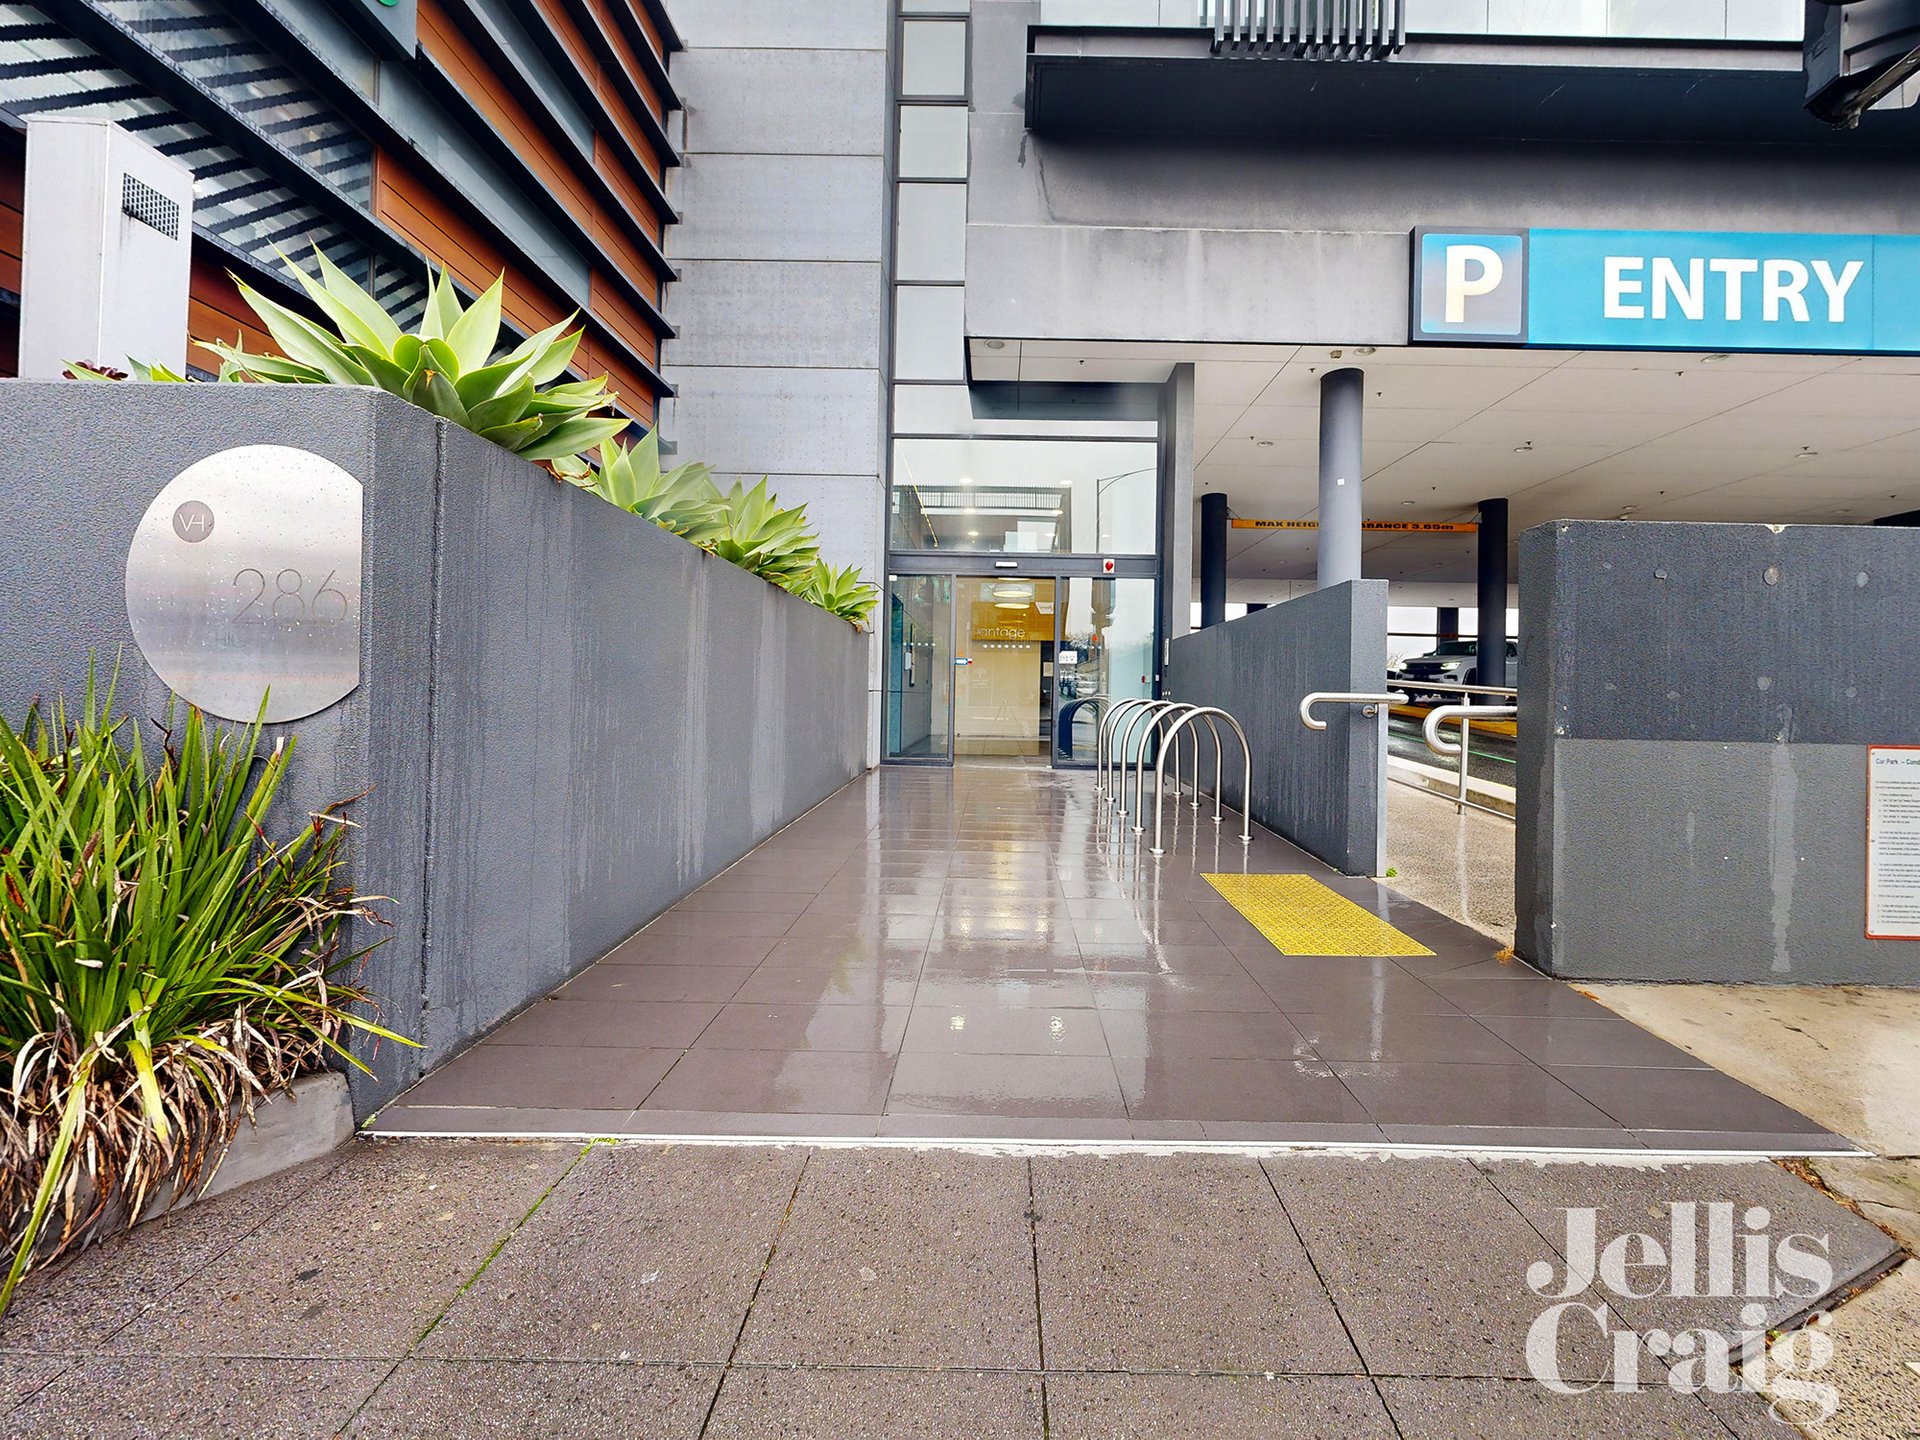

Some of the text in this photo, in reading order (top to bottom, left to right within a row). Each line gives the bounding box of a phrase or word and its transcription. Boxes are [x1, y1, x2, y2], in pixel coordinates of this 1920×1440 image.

[1445, 244, 1865, 323] P ENTRY
[179, 513, 205, 532] VH
[232, 568, 348, 625] 286
[973, 626, 1026, 640] vantage
